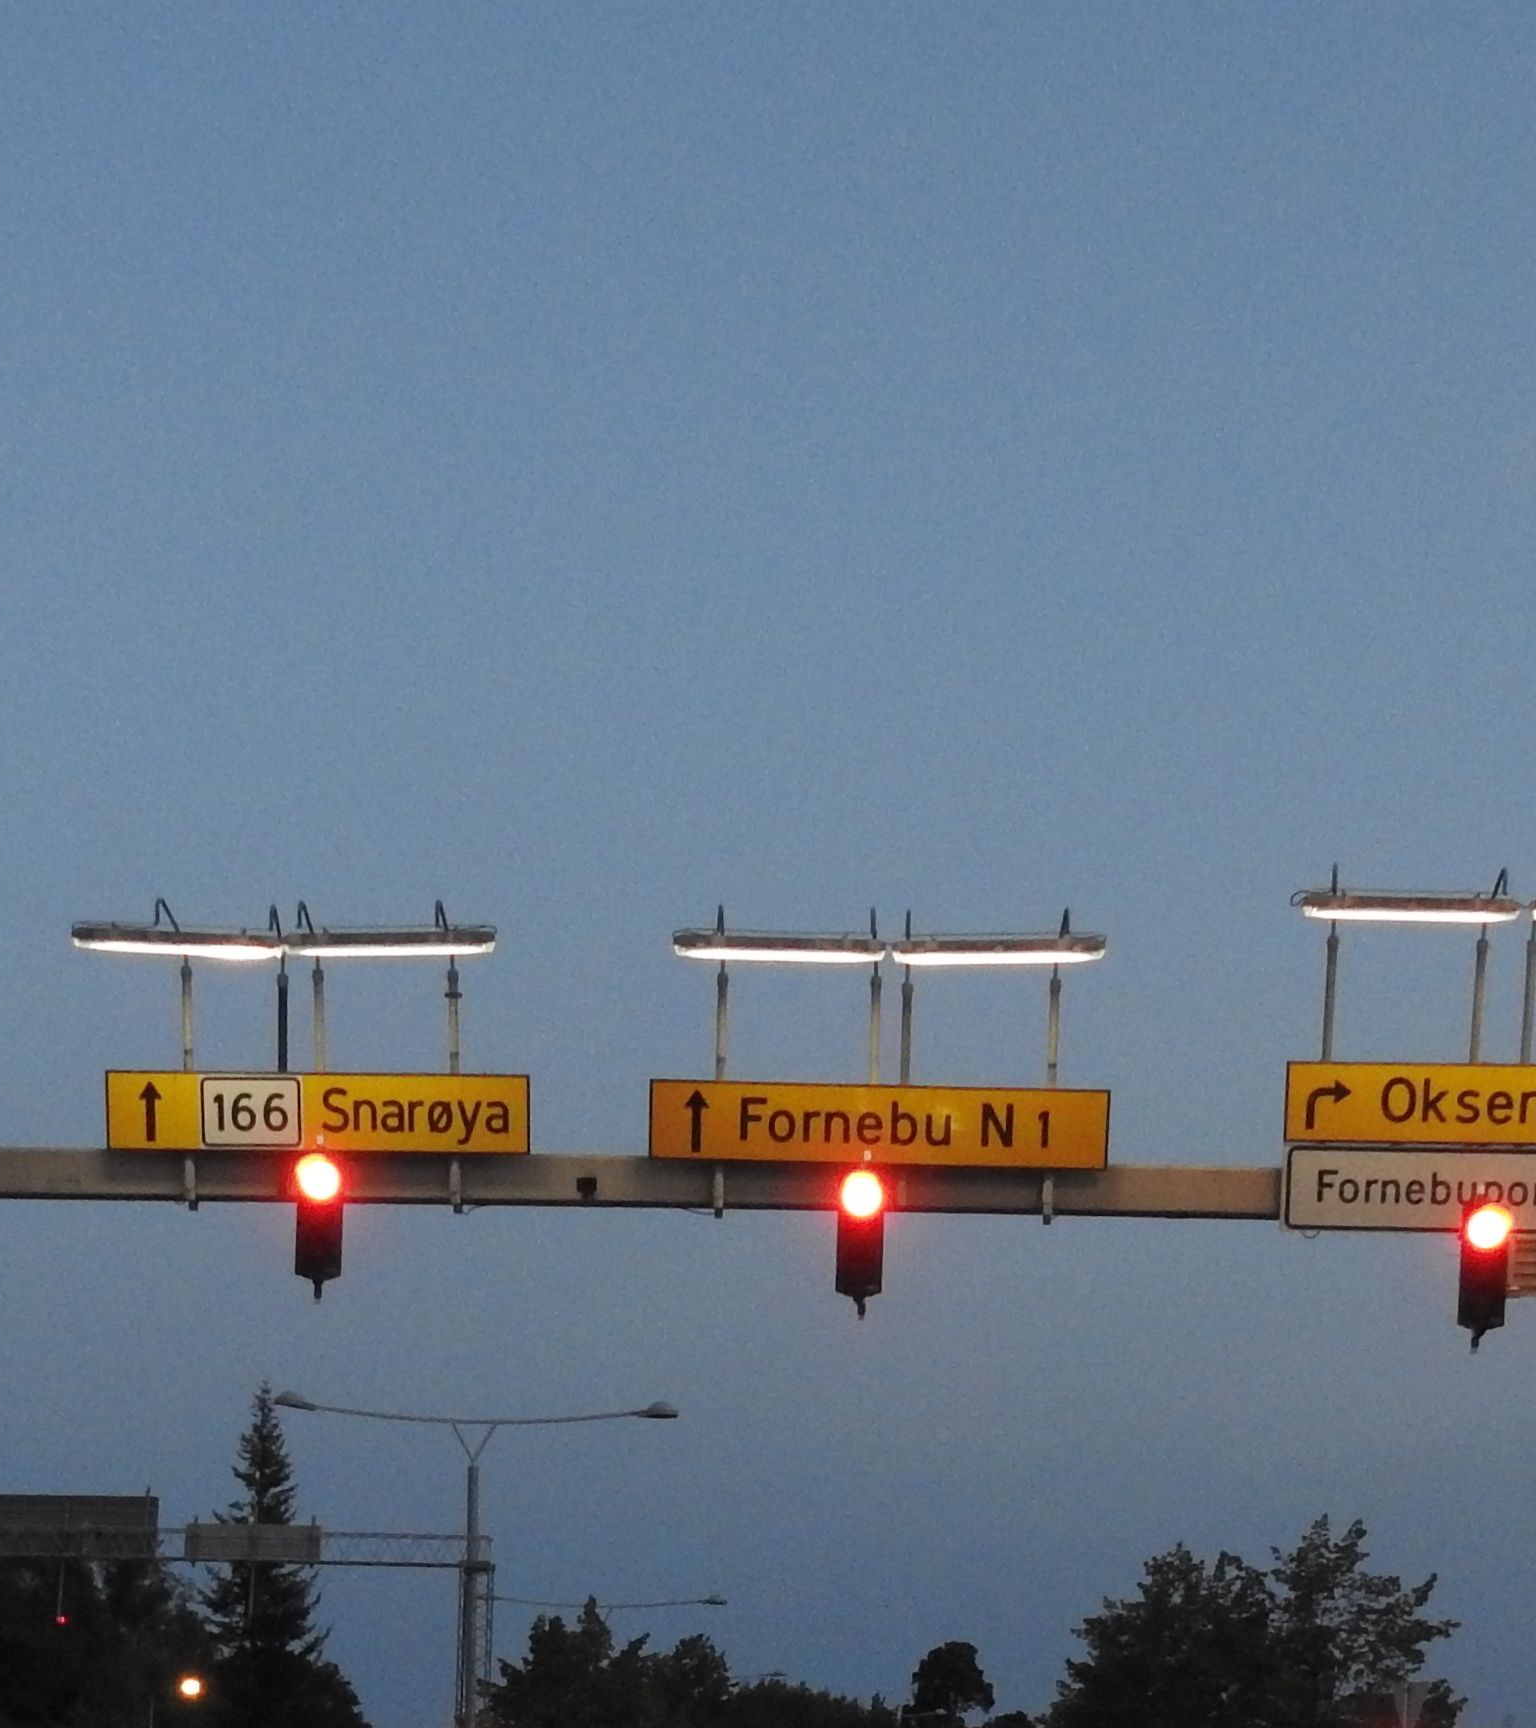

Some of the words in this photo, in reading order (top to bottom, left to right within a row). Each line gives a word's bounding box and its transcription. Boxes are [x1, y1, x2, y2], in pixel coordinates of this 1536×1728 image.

[212, 1092, 290, 1133] 166
[321, 1087, 511, 1145] Snarøya
[738, 1096, 952, 1147] Fornebu
[980, 1102, 1015, 1148] N
[1036, 1109, 1051, 1149] 1
